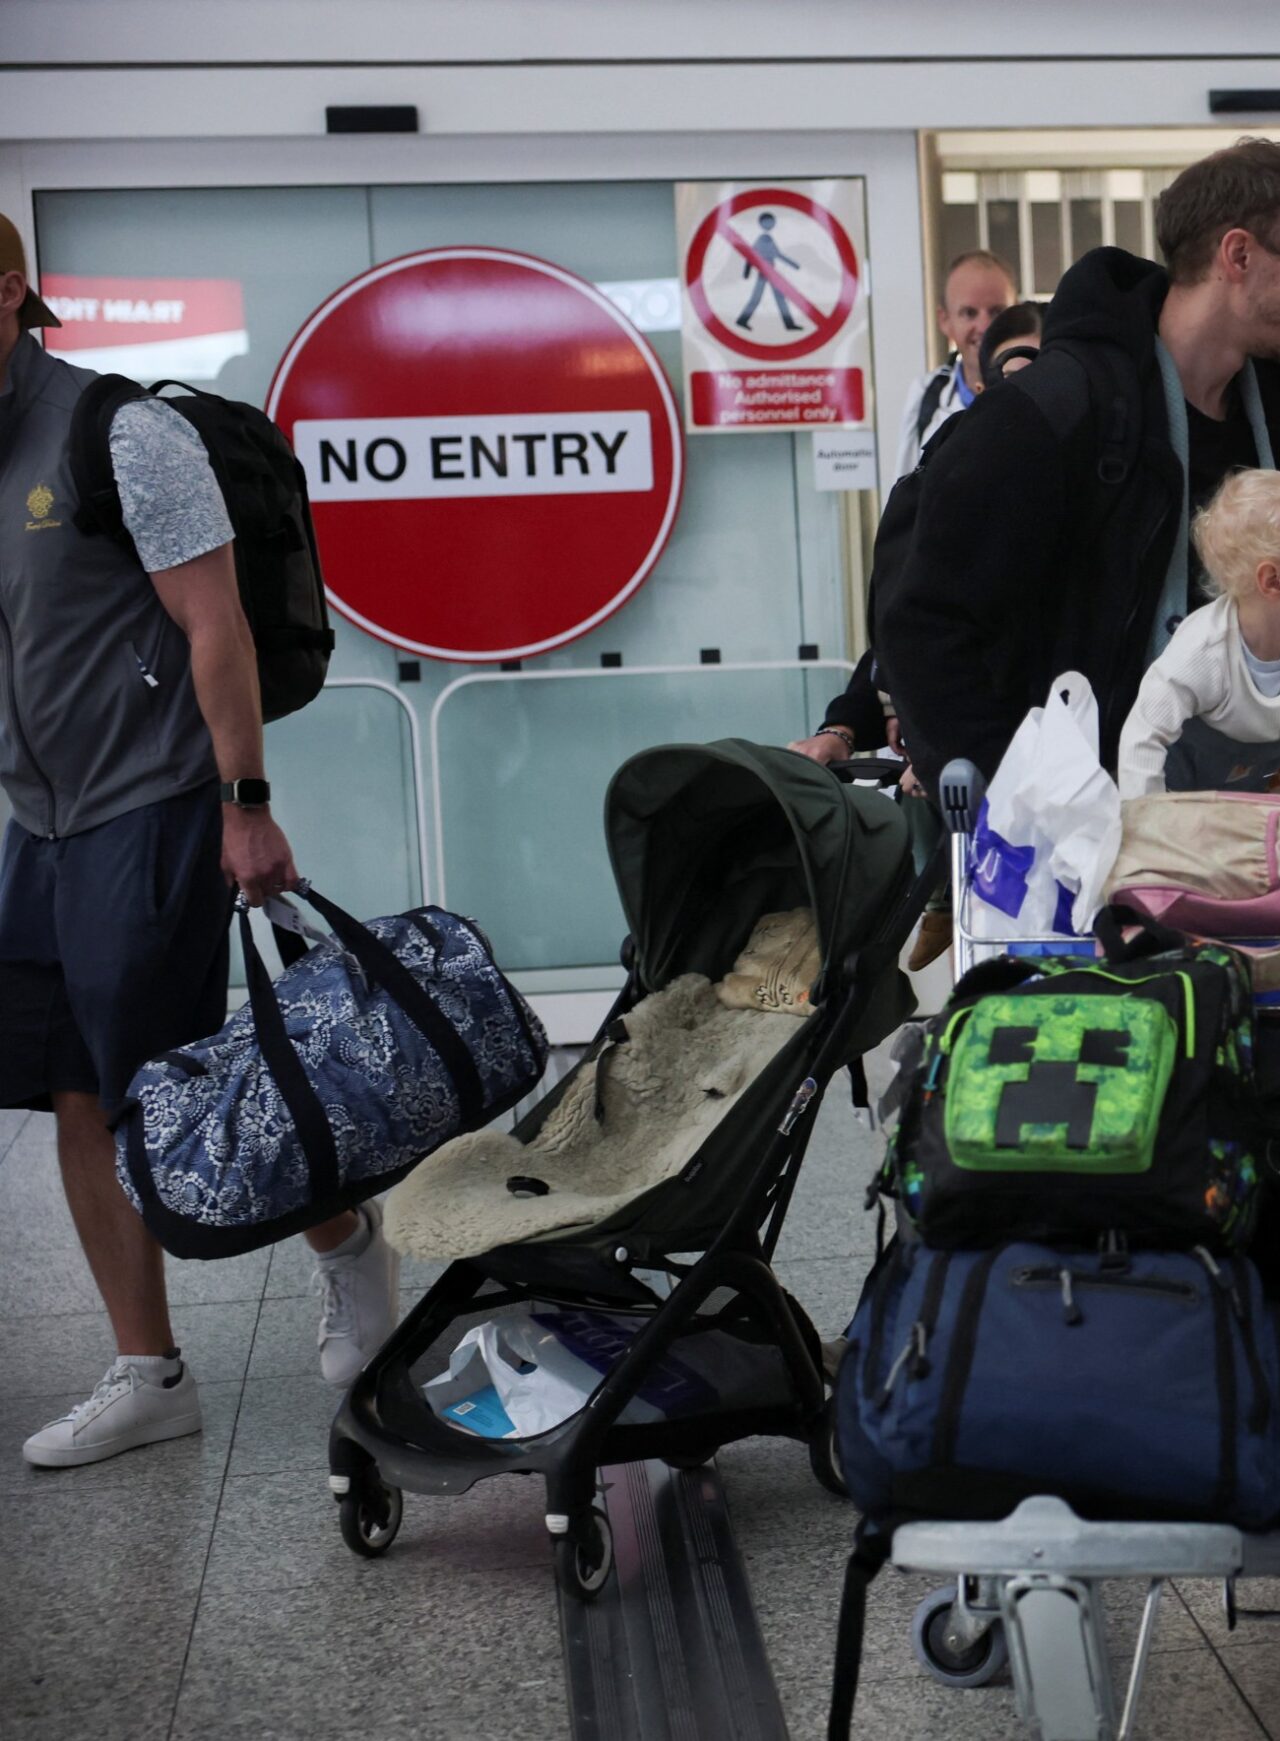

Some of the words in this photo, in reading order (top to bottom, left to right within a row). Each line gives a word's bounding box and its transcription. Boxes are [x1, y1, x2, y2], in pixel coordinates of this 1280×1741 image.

[718, 375, 742, 389] No
[745, 373, 836, 388] admittance
[735, 389, 822, 404] Authorised
[720, 406, 800, 424] personnel
[803, 405, 838, 422] only
[319, 437, 408, 483] NO
[430, 430, 629, 480] ENTRY
[817, 449, 873, 460] Automatic
[832, 461, 860, 472] door
